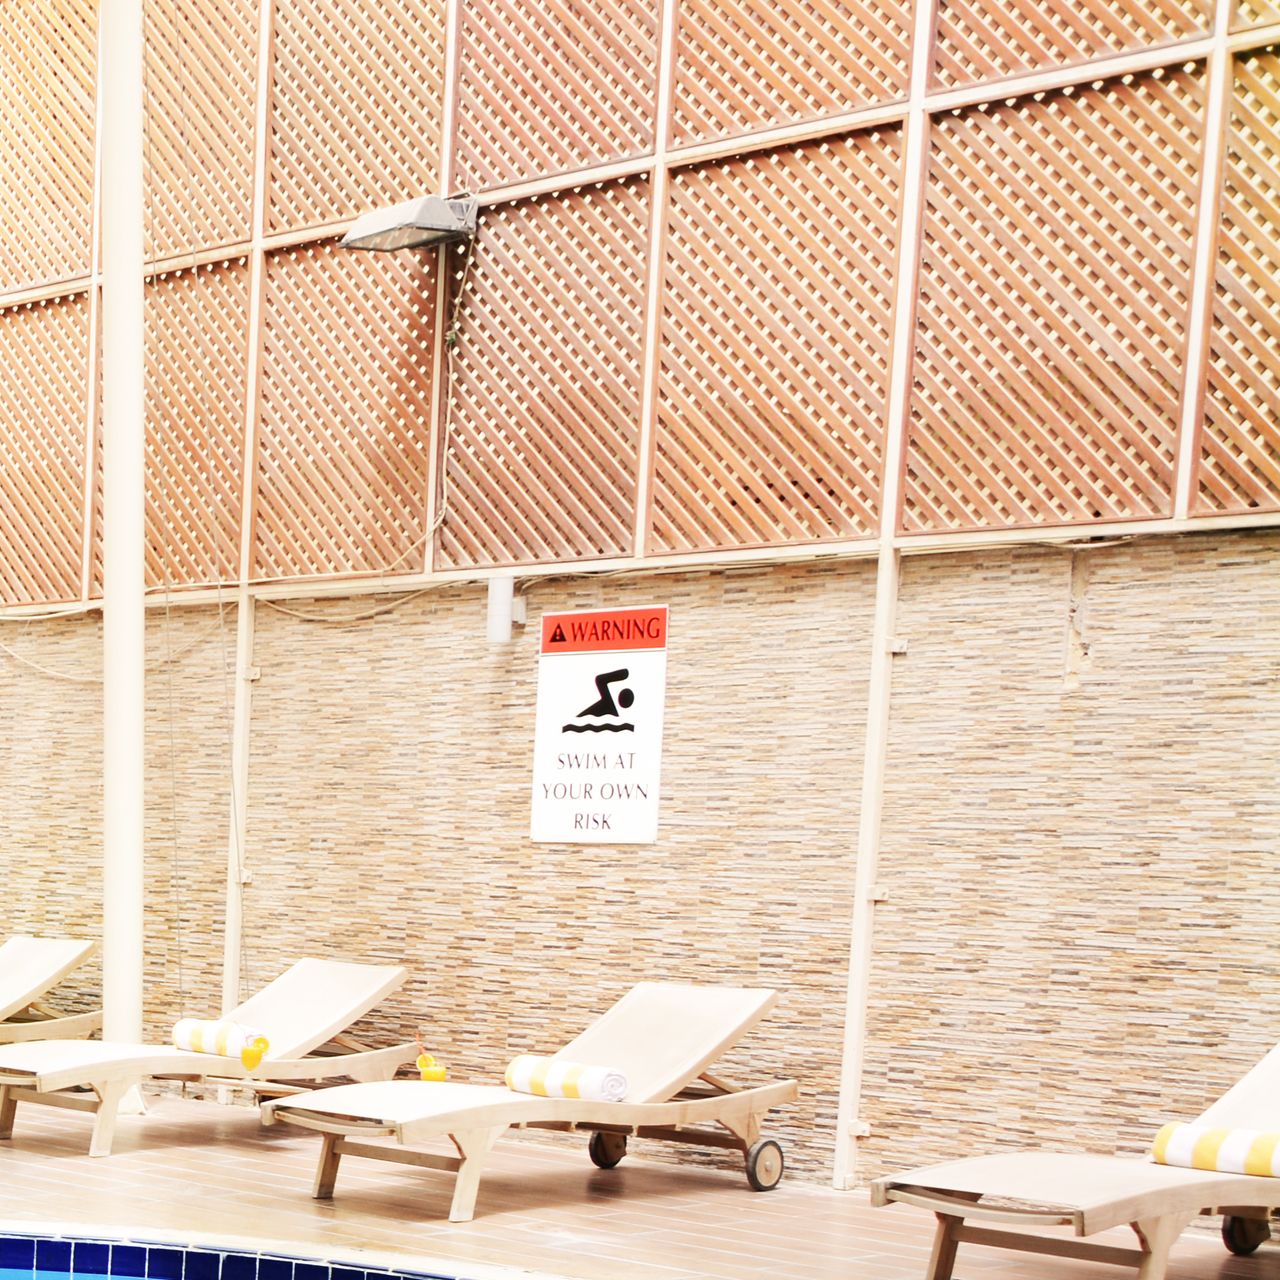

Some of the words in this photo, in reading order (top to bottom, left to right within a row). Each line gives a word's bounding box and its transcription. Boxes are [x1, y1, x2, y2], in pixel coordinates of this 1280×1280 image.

[571, 617, 660, 642] WARNING
[557, 753, 607, 769] SWIM
[613, 753, 636, 769] AT
[543, 783, 593, 800] YOUR
[600, 783, 648, 800] OWN
[574, 813, 612, 830] RISK
